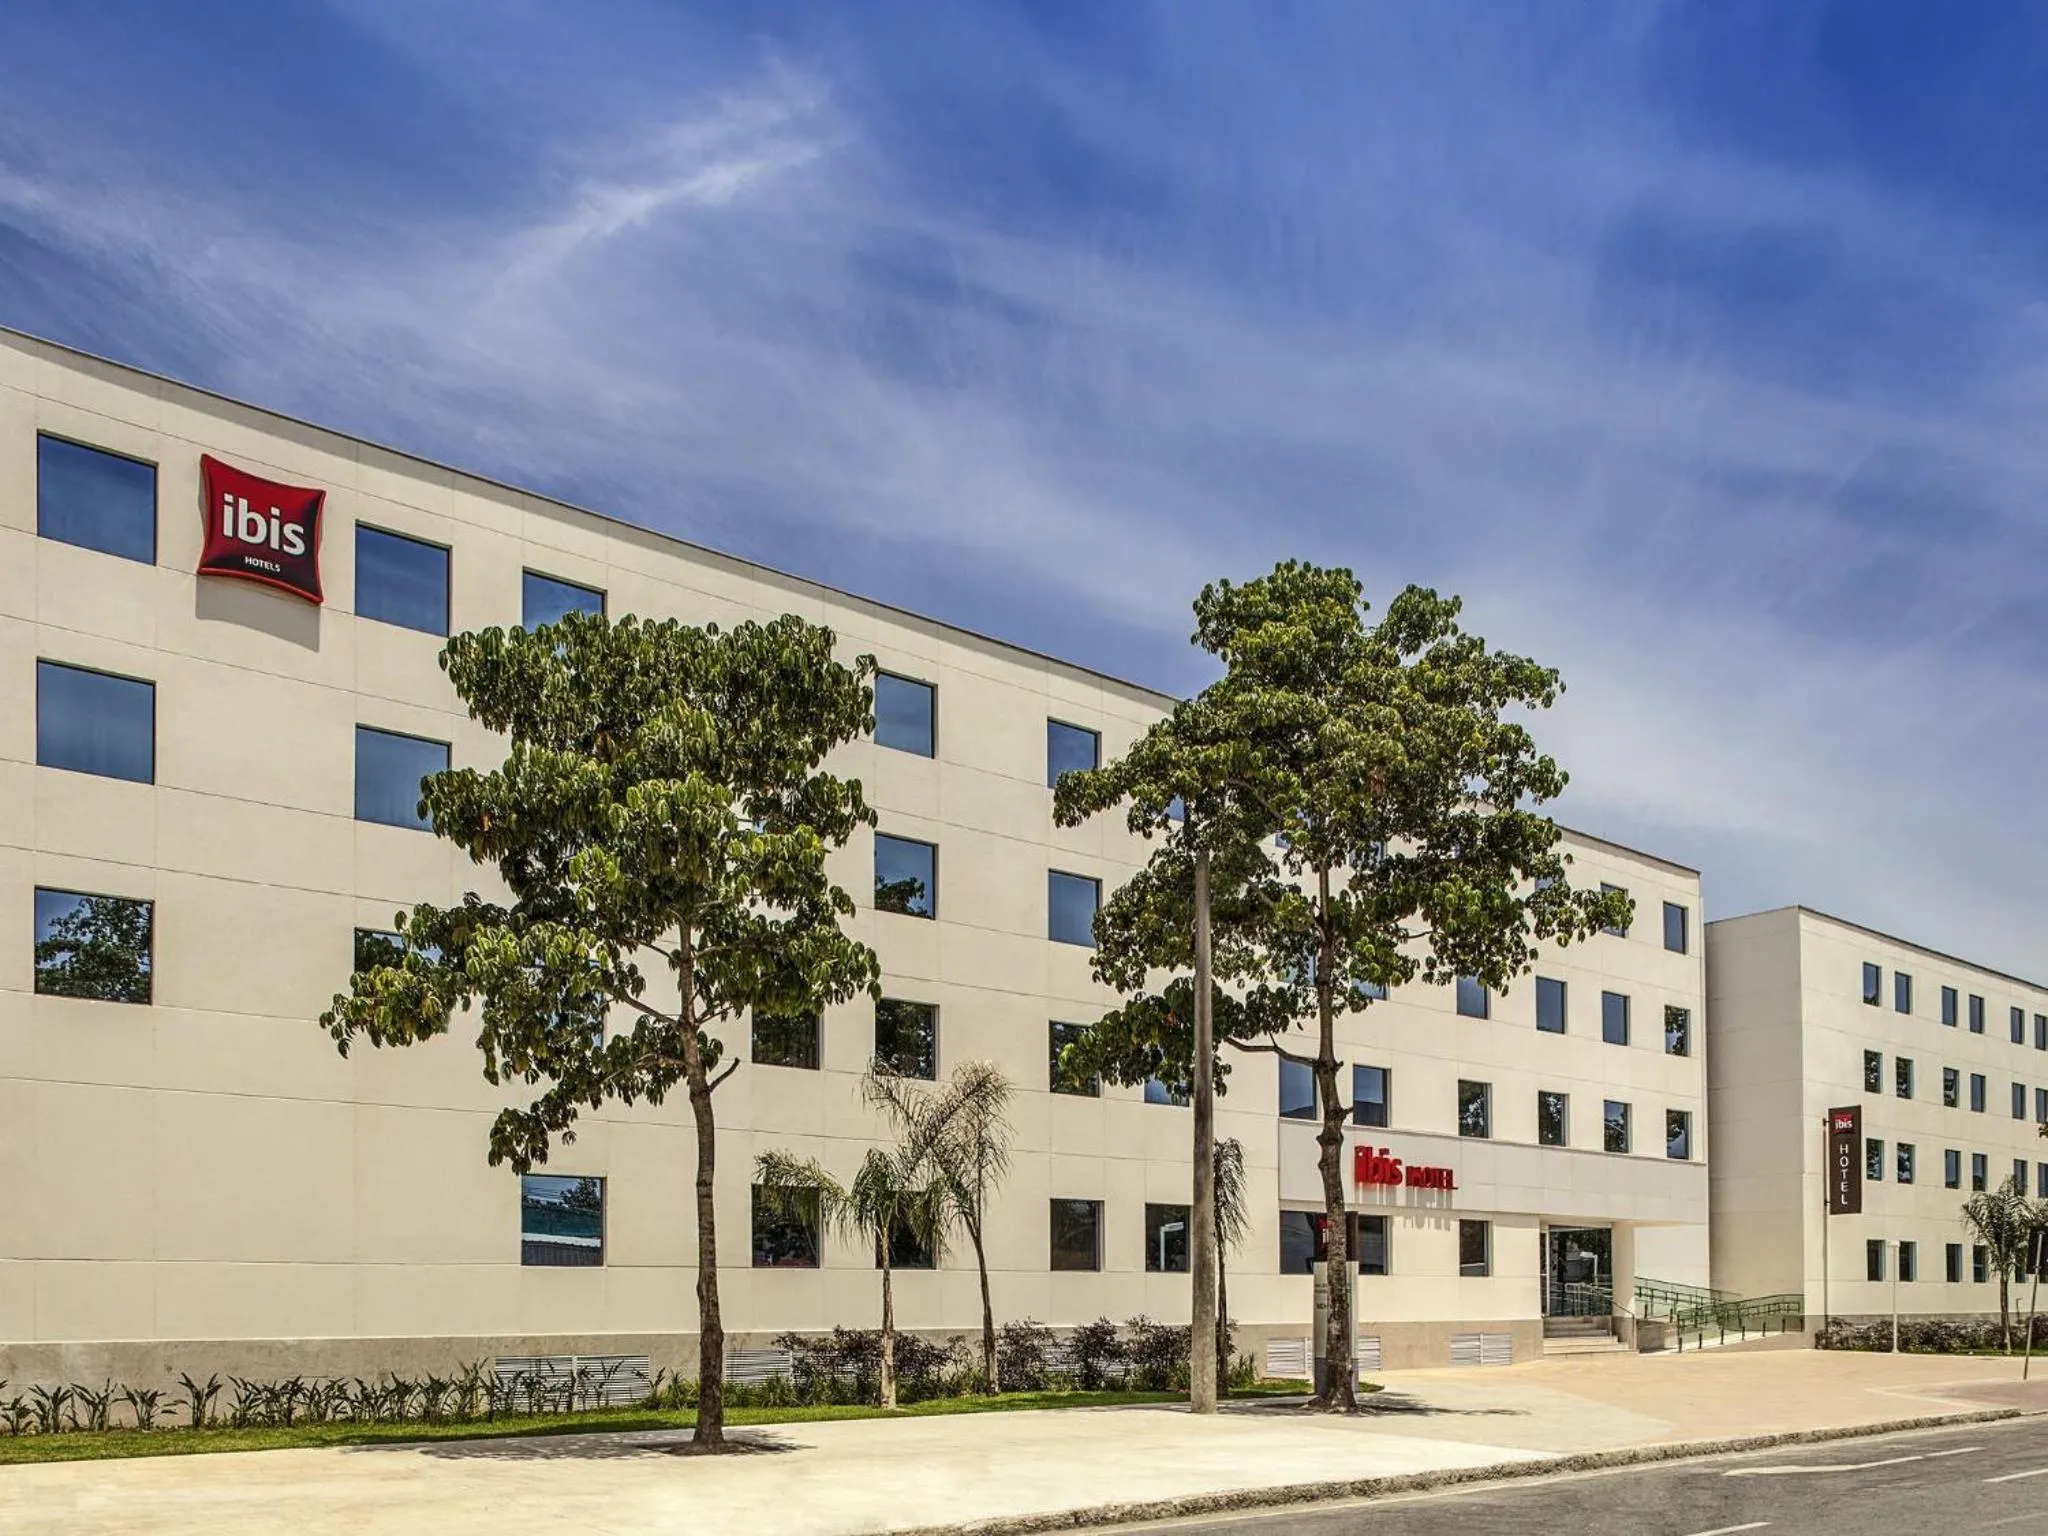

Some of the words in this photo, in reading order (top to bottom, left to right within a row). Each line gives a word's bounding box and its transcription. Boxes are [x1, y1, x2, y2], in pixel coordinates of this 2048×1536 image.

[223, 493, 305, 556] ibis
[244, 556, 281, 572] HOTELS
[1834, 1119, 1852, 1130] ibis
[1354, 1145, 1403, 1185] ibis
[1405, 1165, 1458, 1190] HOTEL
[1839, 1143, 1849, 1205] HOTEL
